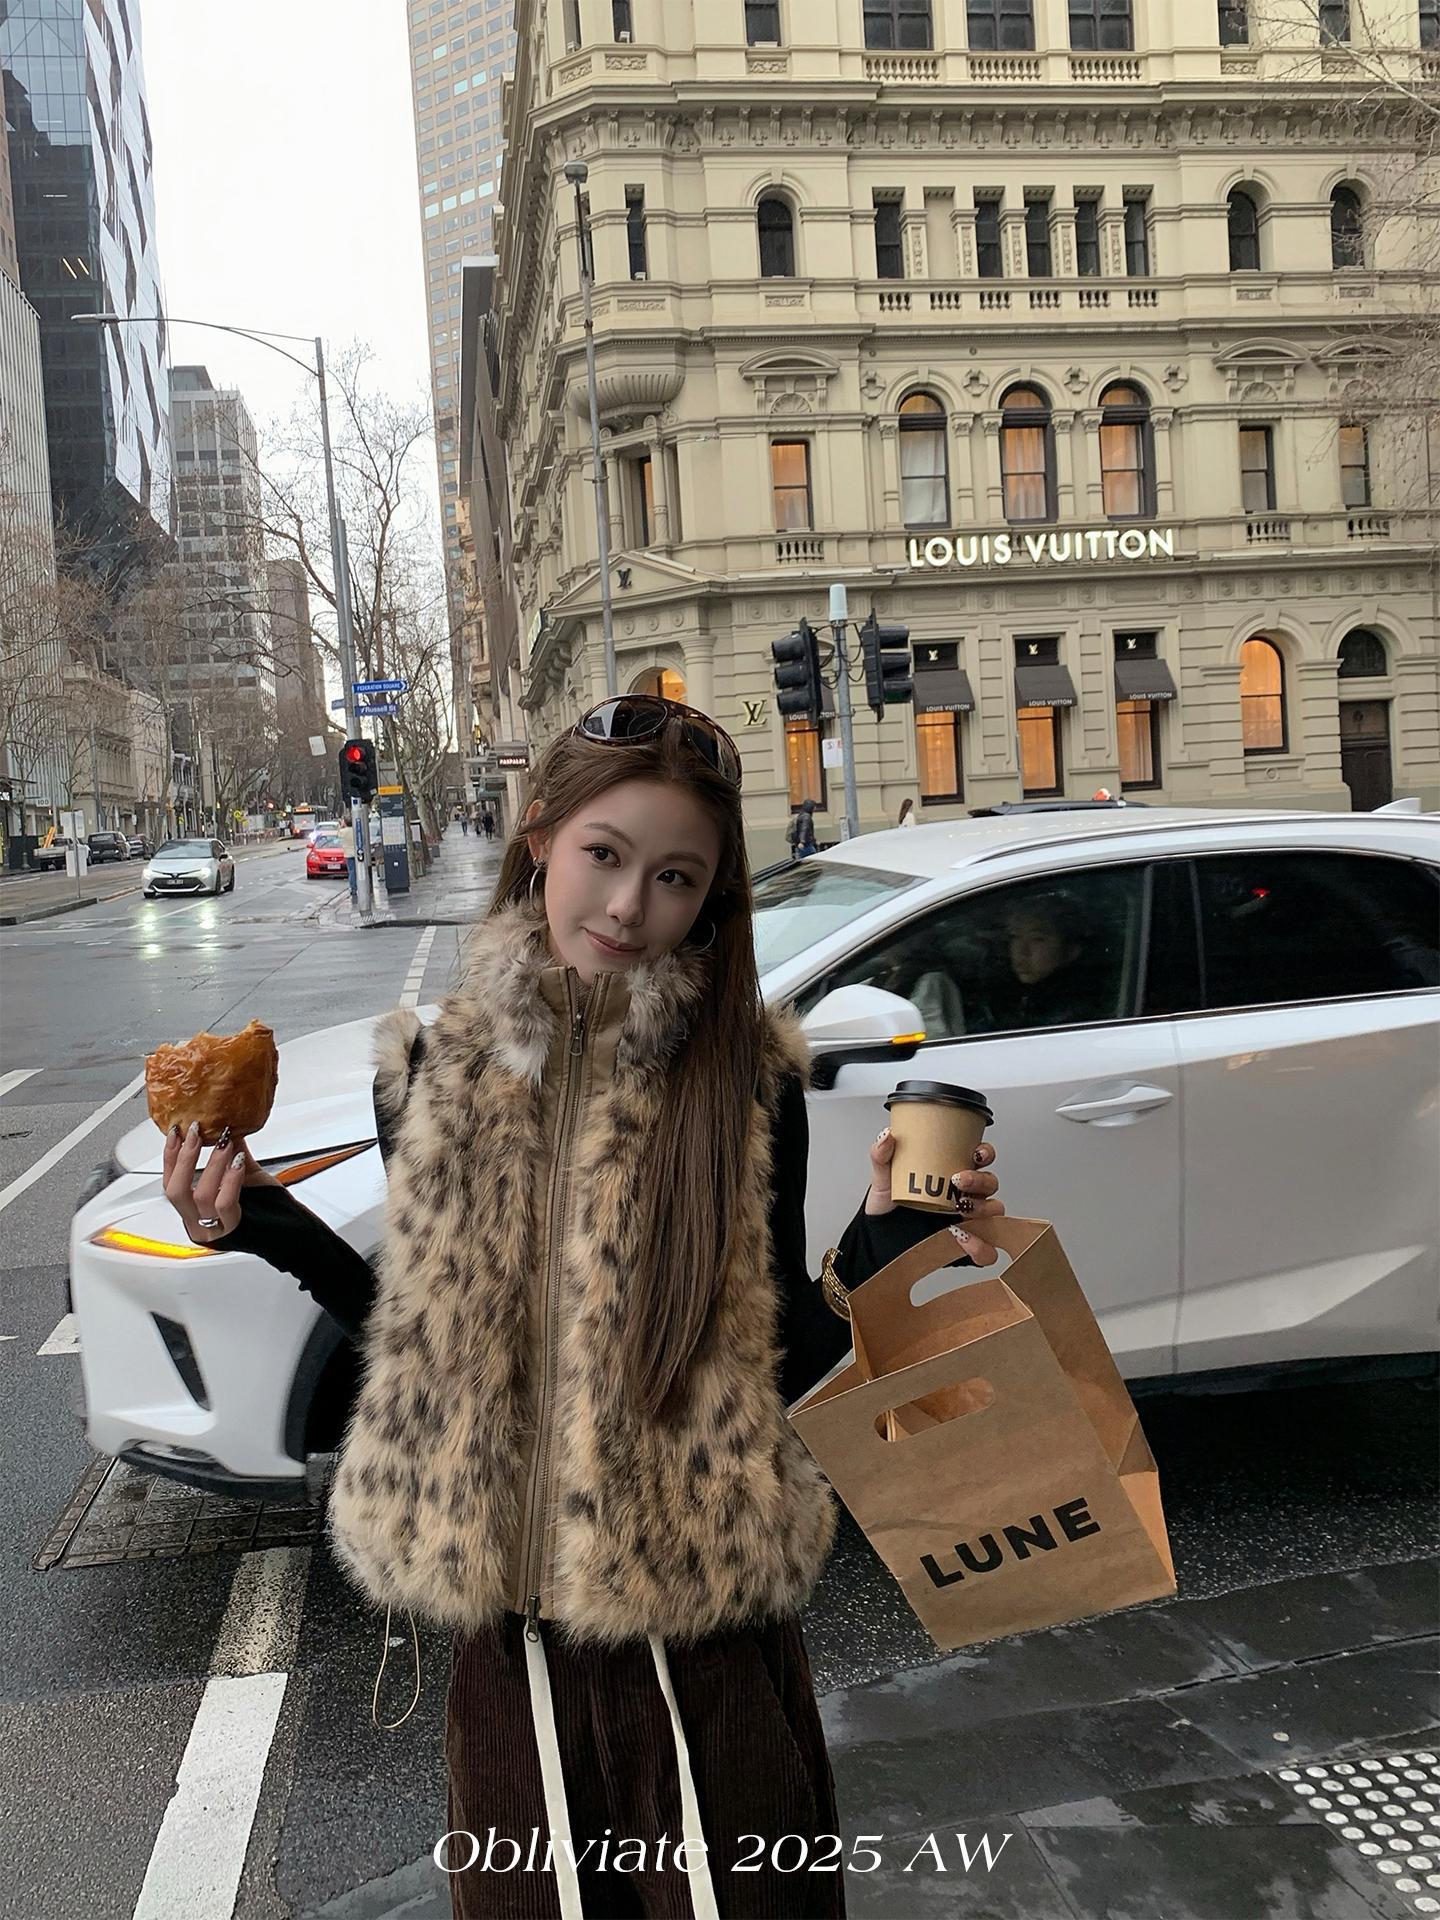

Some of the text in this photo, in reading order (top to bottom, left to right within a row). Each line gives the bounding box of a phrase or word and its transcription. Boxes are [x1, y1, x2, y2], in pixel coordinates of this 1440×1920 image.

[908, 528, 1175, 569] LOUIS VUITTON
[365, 704, 387, 713] Russell
[1047, 698, 1073, 706] VUITTON
[789, 713, 808, 721] LOUIS
[908, 1172, 961, 1202] LUN
[919, 1496, 1102, 1589] LUNE
